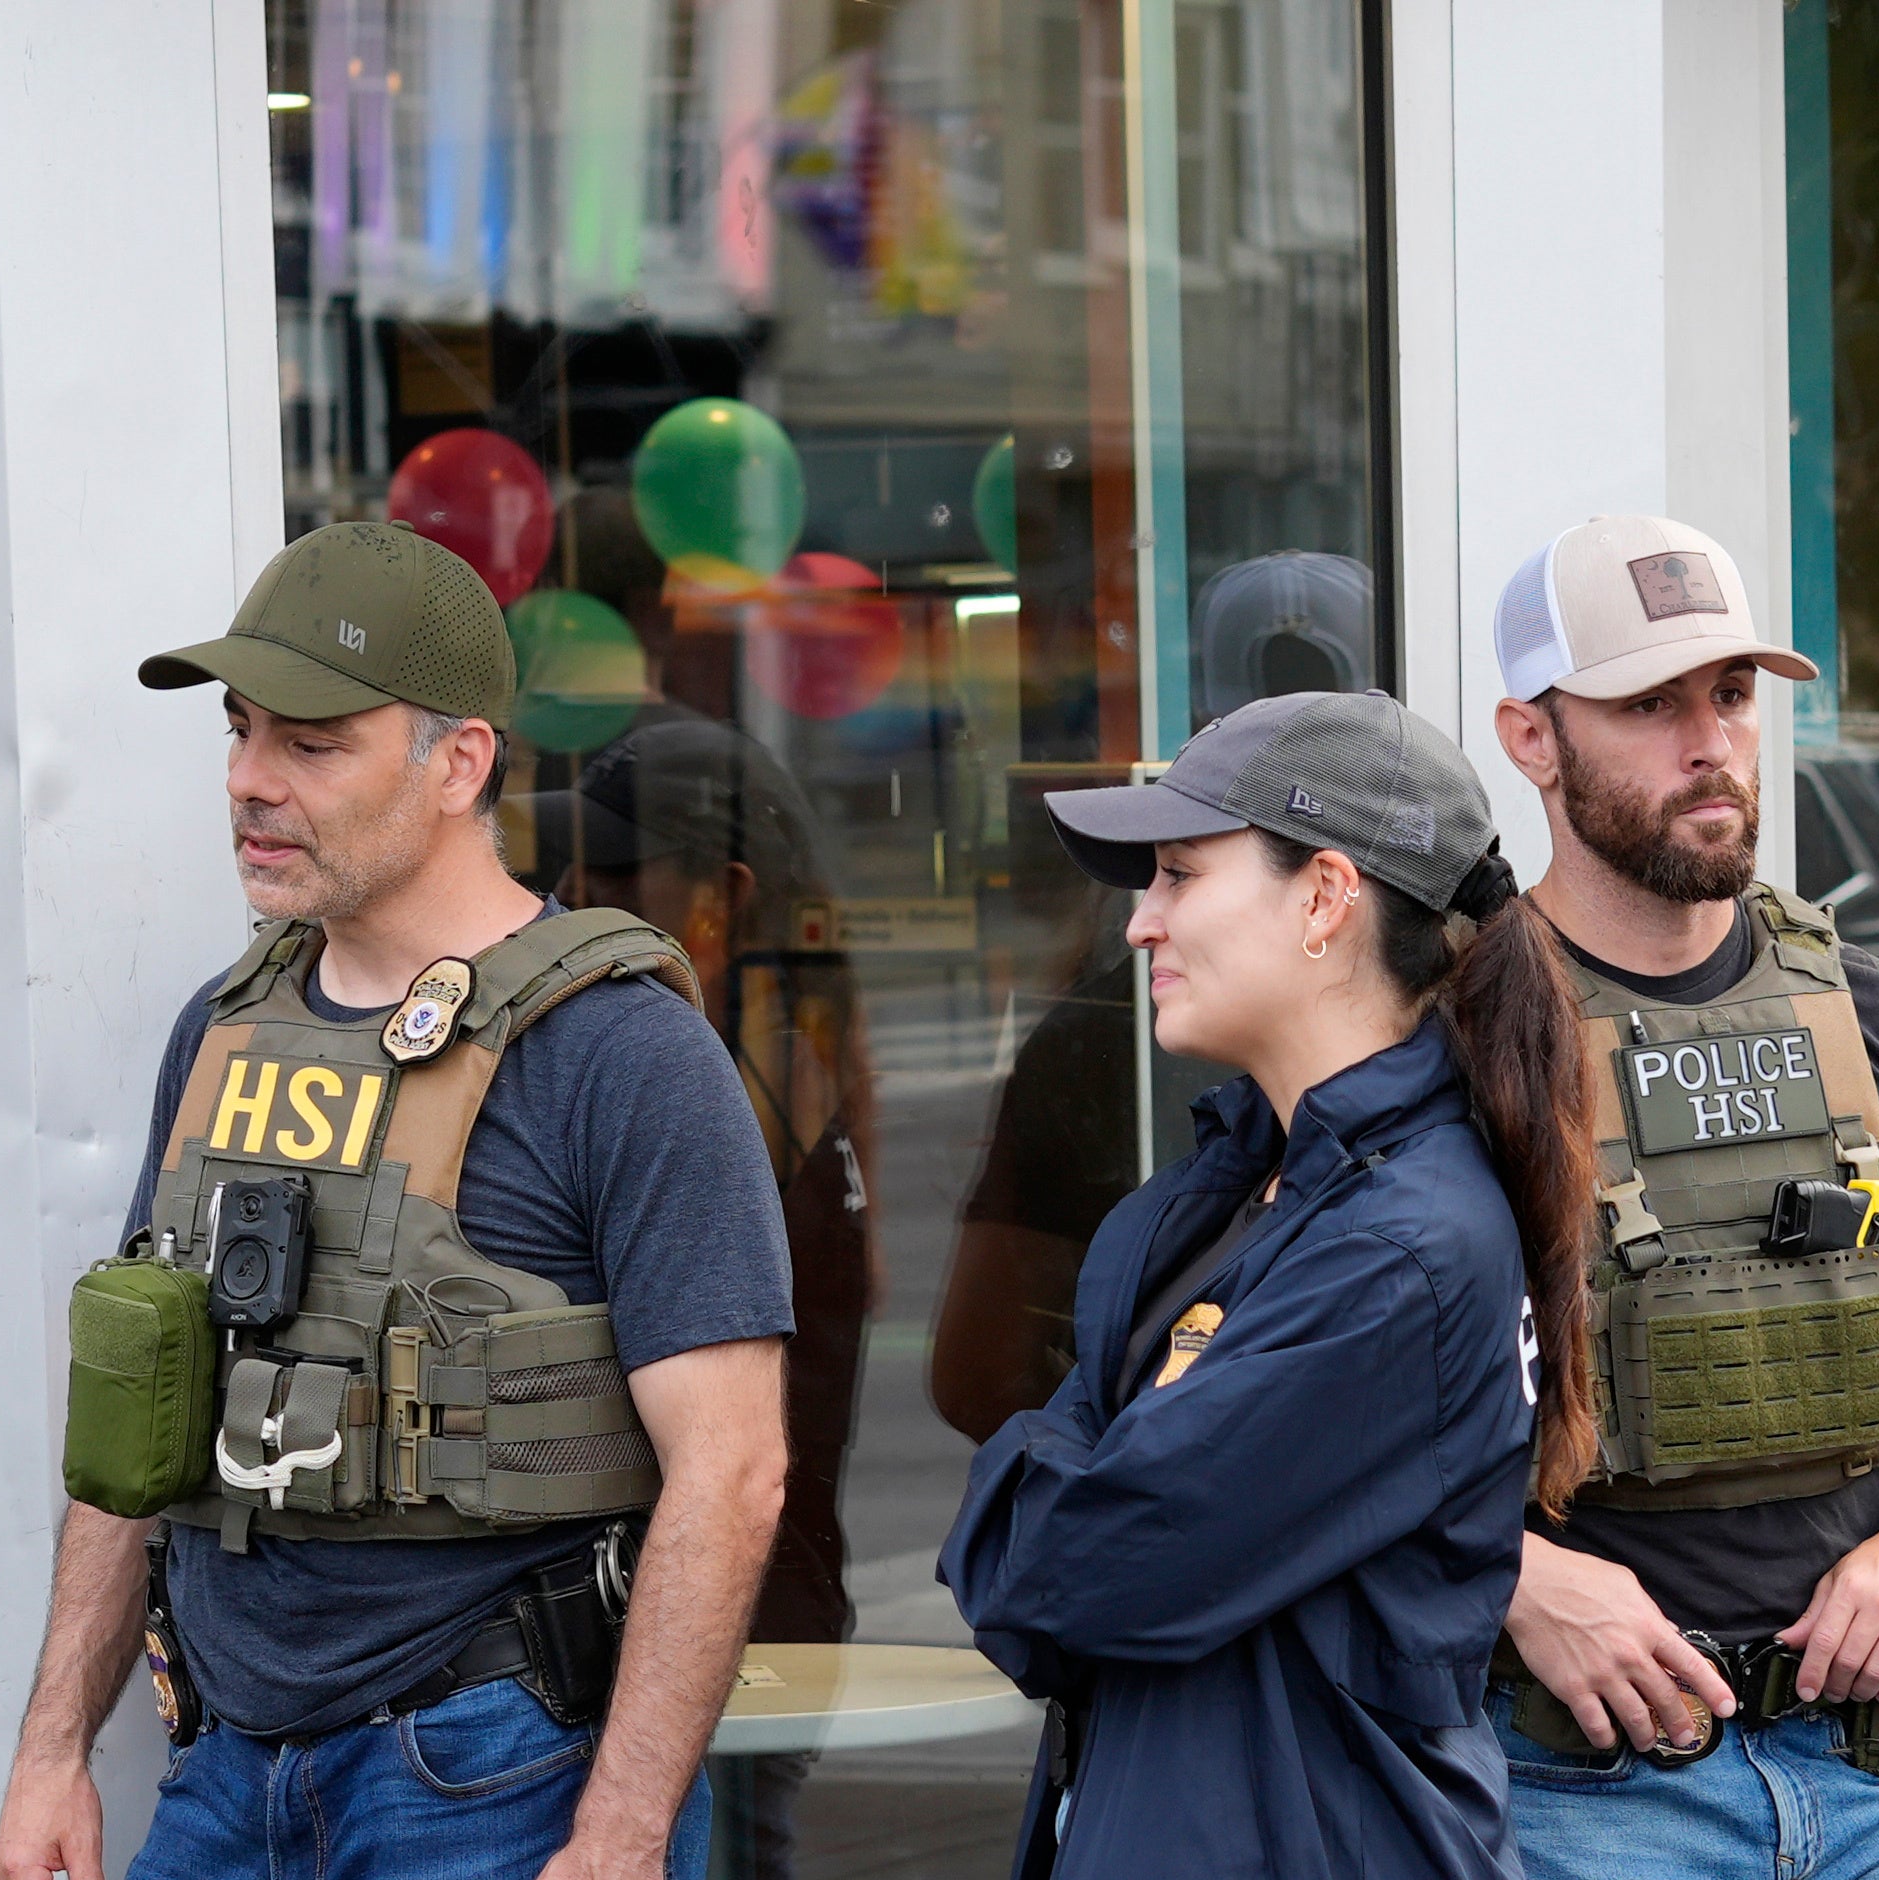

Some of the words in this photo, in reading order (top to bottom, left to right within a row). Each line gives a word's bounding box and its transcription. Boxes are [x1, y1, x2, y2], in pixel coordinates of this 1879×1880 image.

[1632, 1034, 1813, 1098] POLICE
[209, 1059, 382, 1166] HSI
[1688, 1087, 1785, 1141] HSI
